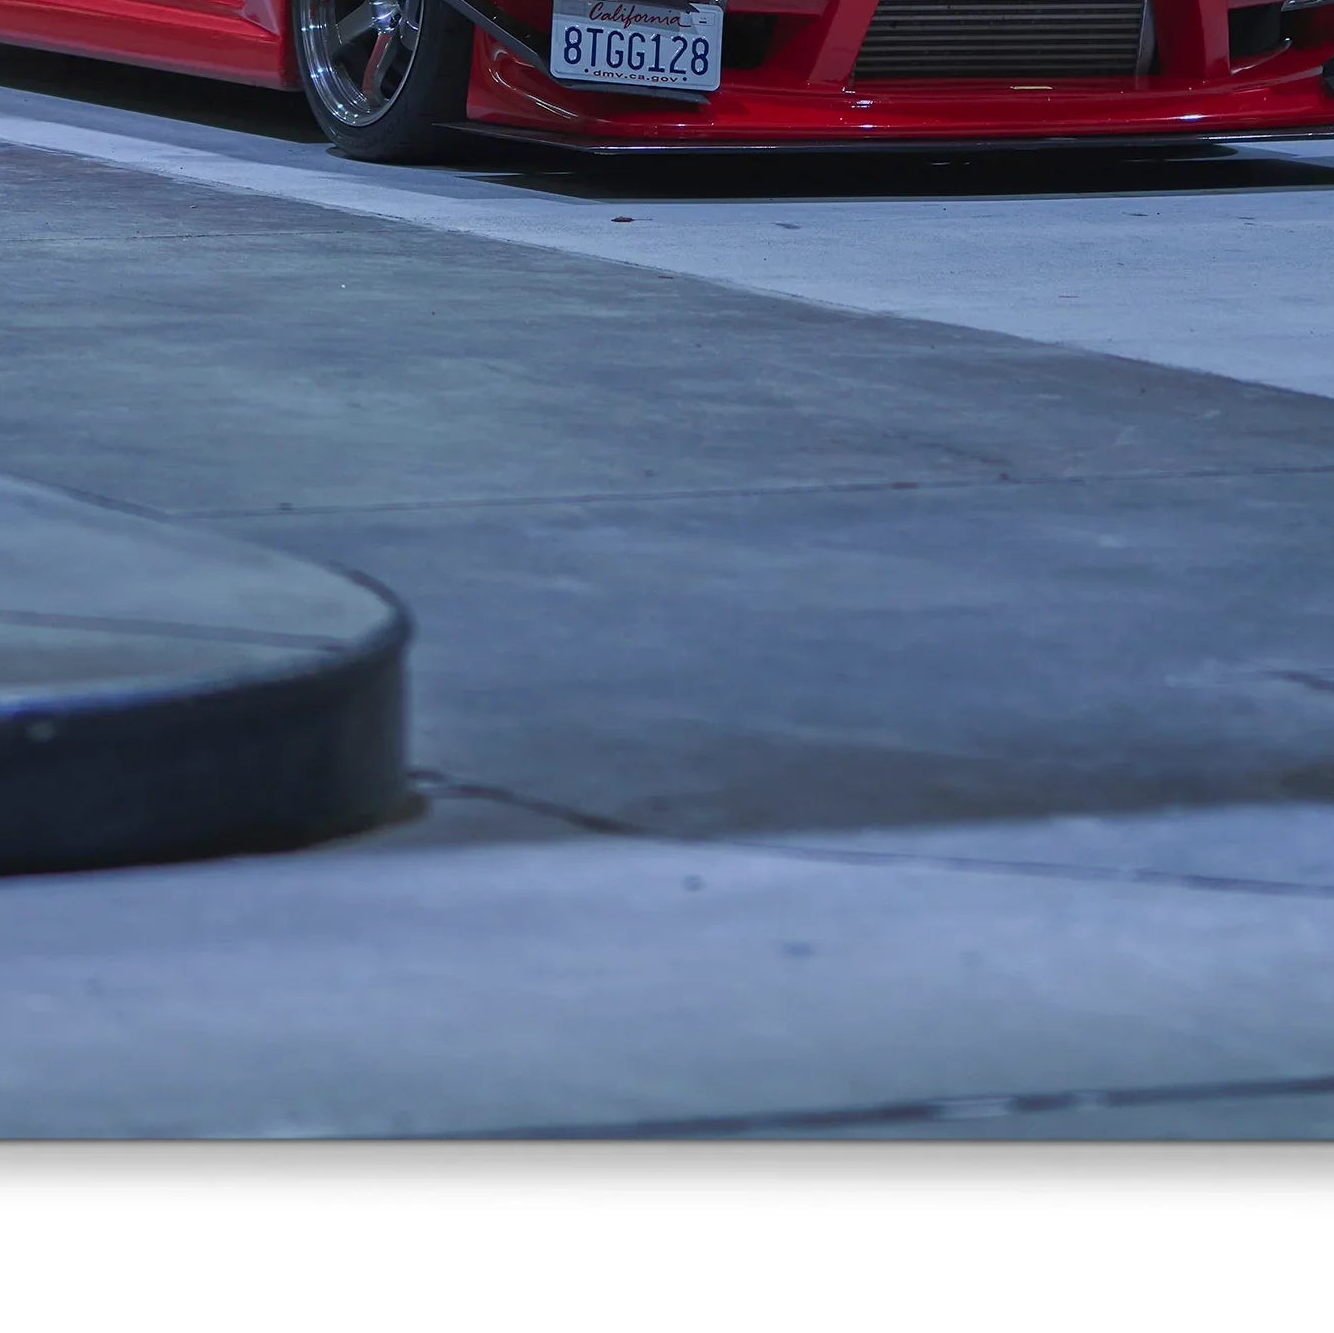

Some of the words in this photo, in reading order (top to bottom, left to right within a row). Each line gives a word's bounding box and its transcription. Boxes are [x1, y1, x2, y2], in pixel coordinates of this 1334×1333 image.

[588, 1, 692, 30] California
[563, 25, 710, 76] 8TGG128
[592, 68, 679, 84] dmv.ca.gov
